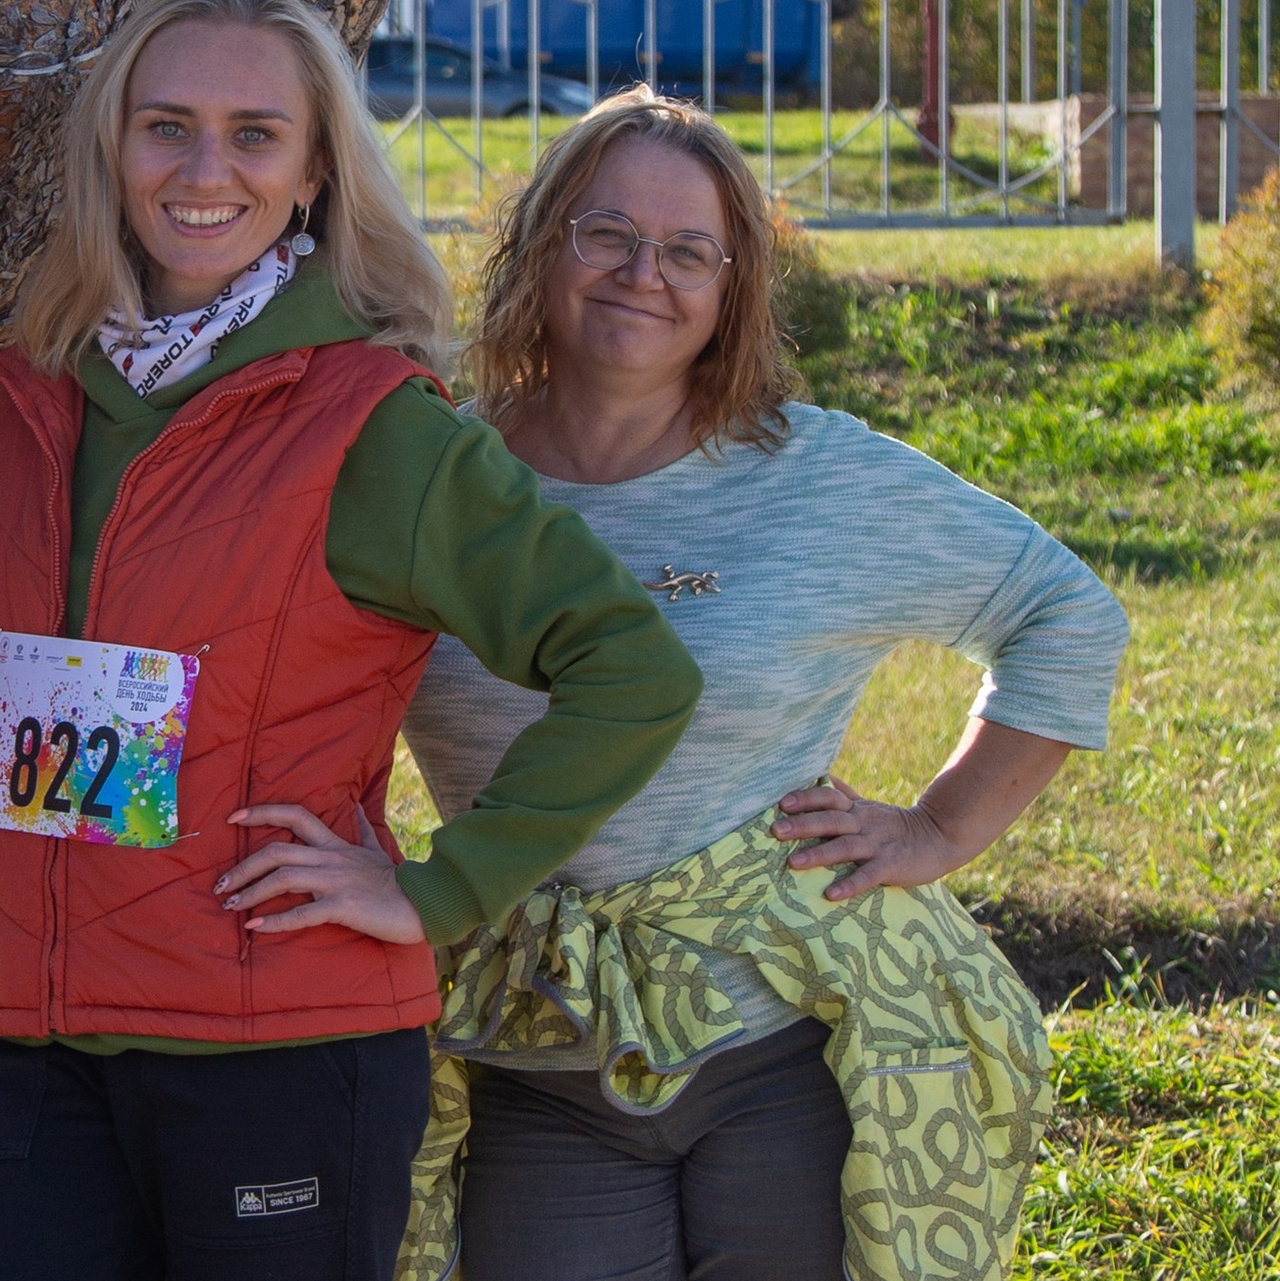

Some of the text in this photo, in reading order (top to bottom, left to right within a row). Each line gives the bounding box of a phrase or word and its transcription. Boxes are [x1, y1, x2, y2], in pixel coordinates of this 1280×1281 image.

[117, 680, 169, 693] ВСЕРОССИЙСКИЙ
[116, 688, 167, 703] ДЕНЬ ХОДЬБЫ
[130, 701, 148, 712] 2024
[10, 717, 120, 819] 822
[270, 1193, 314, 1207] SINCE 1967
[240, 1203, 263, 1212] Kappa
